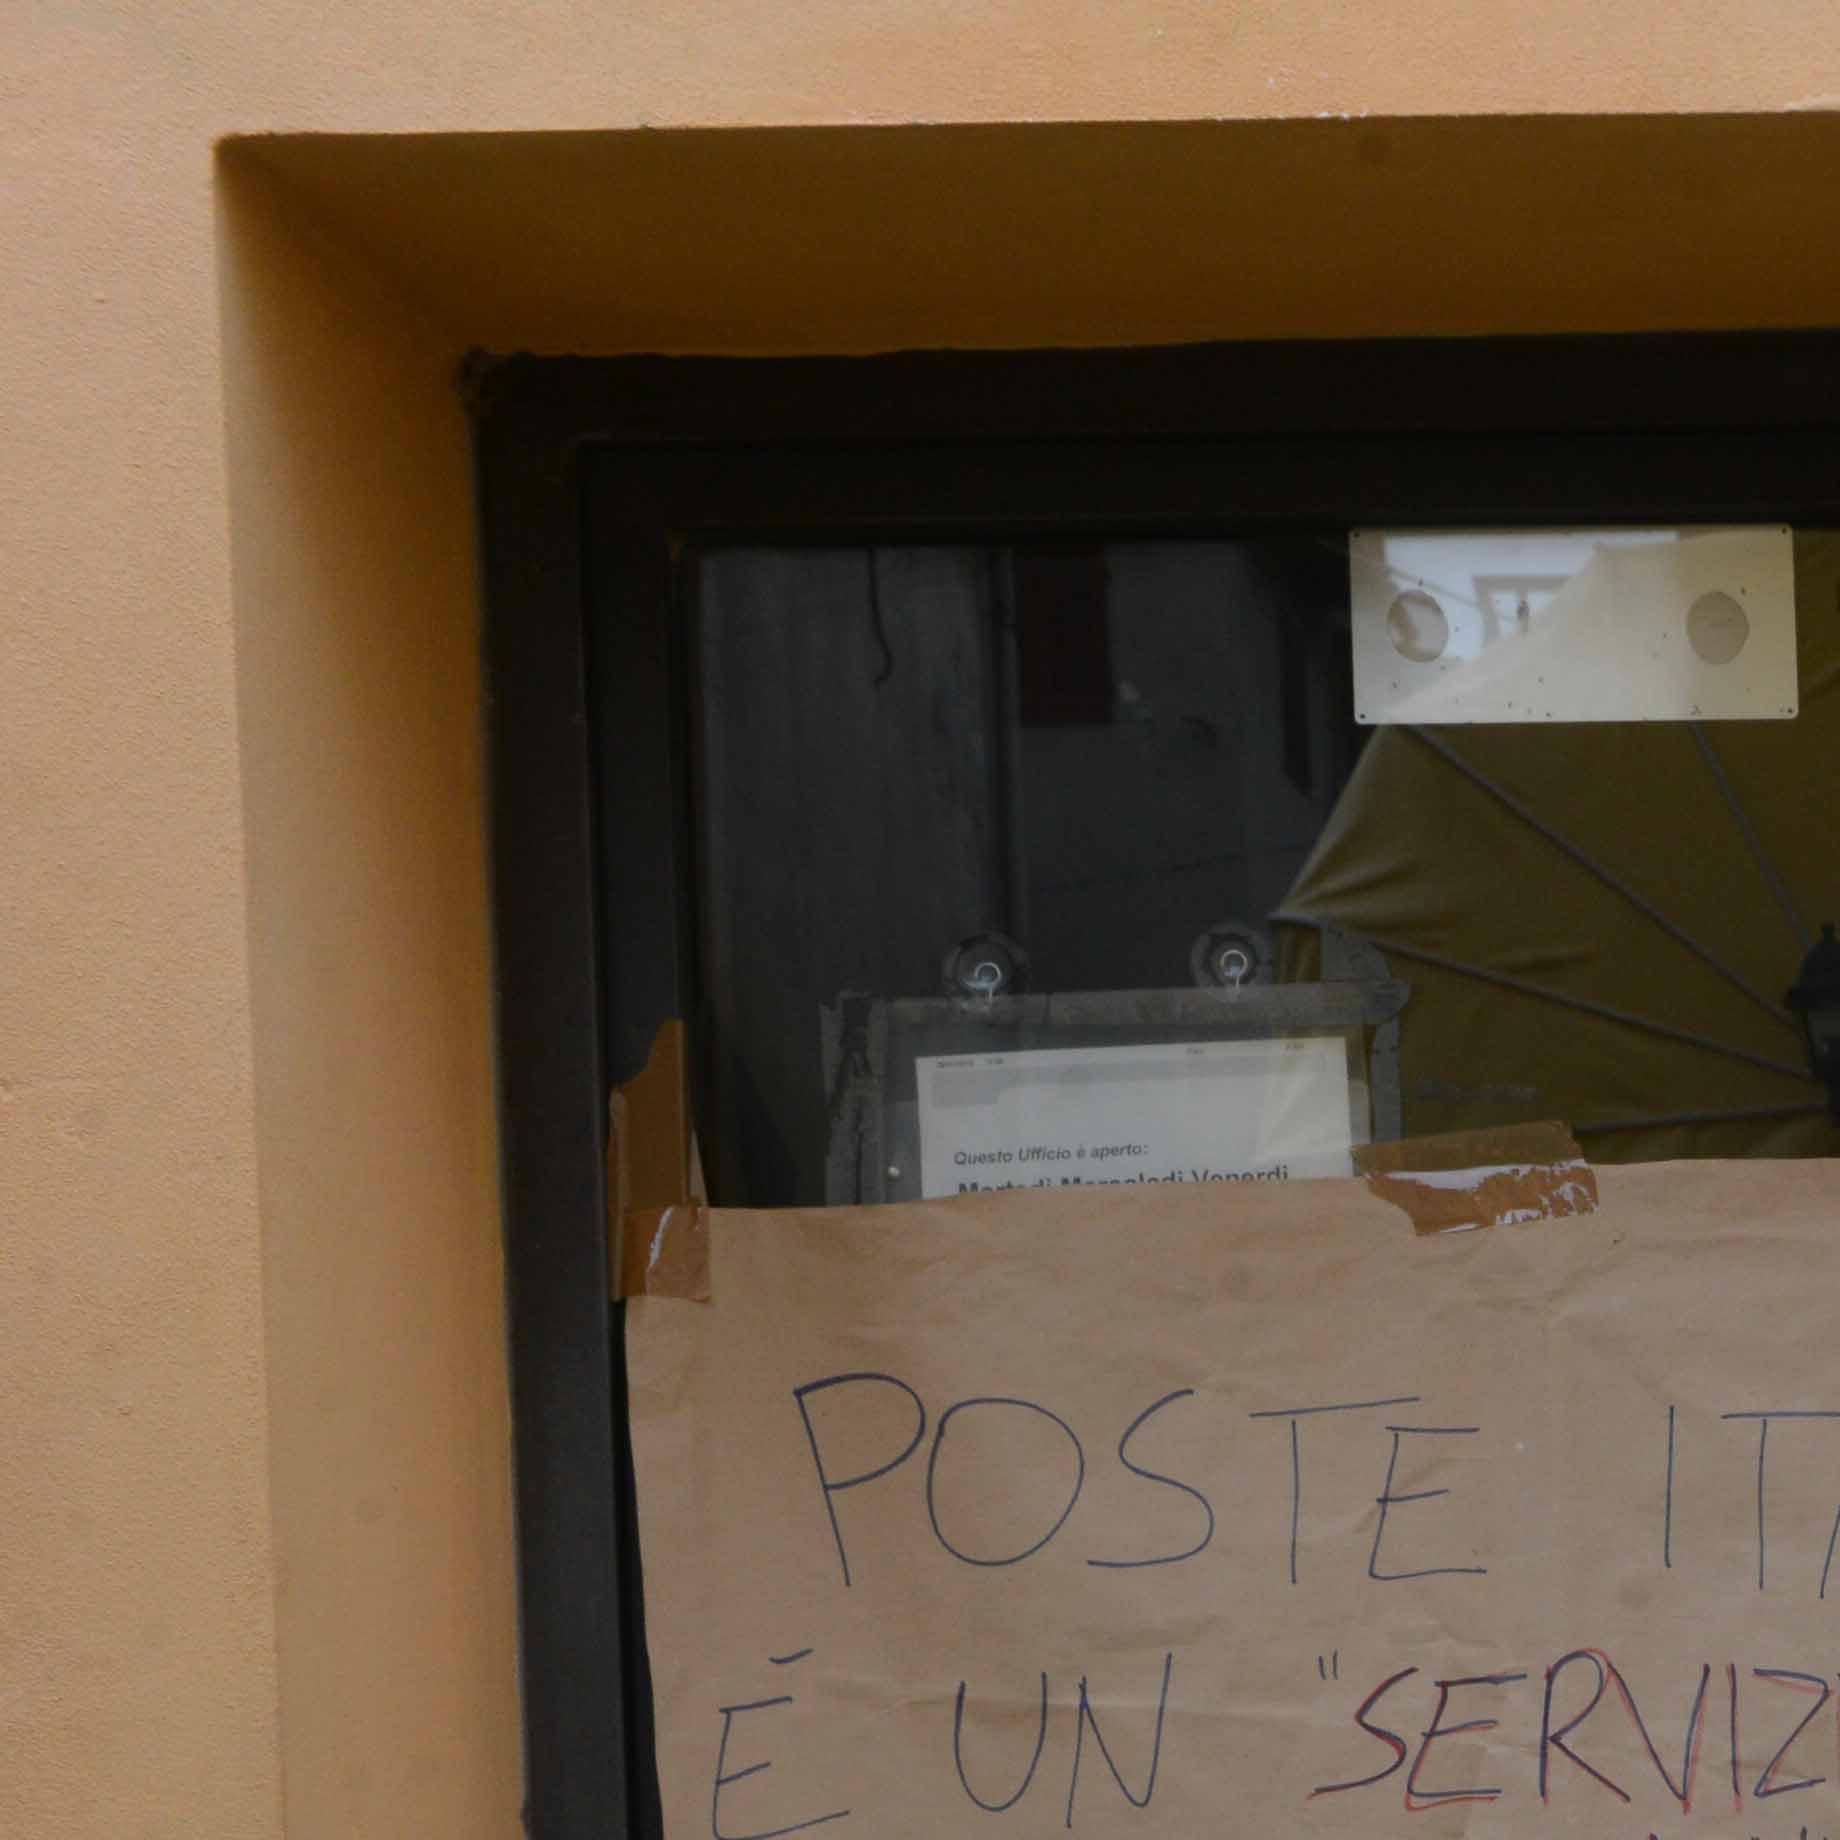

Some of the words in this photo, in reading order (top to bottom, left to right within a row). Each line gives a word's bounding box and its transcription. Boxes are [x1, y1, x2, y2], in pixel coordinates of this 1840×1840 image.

[953, 1149, 1014, 1166] Questo
[1018, 1146, 1072, 1163] Ufficio
[1089, 1143, 1150, 1161] aperto:
[792, 1371, 1488, 1588] POSTE
[953, 1652, 1174, 1829] UN
